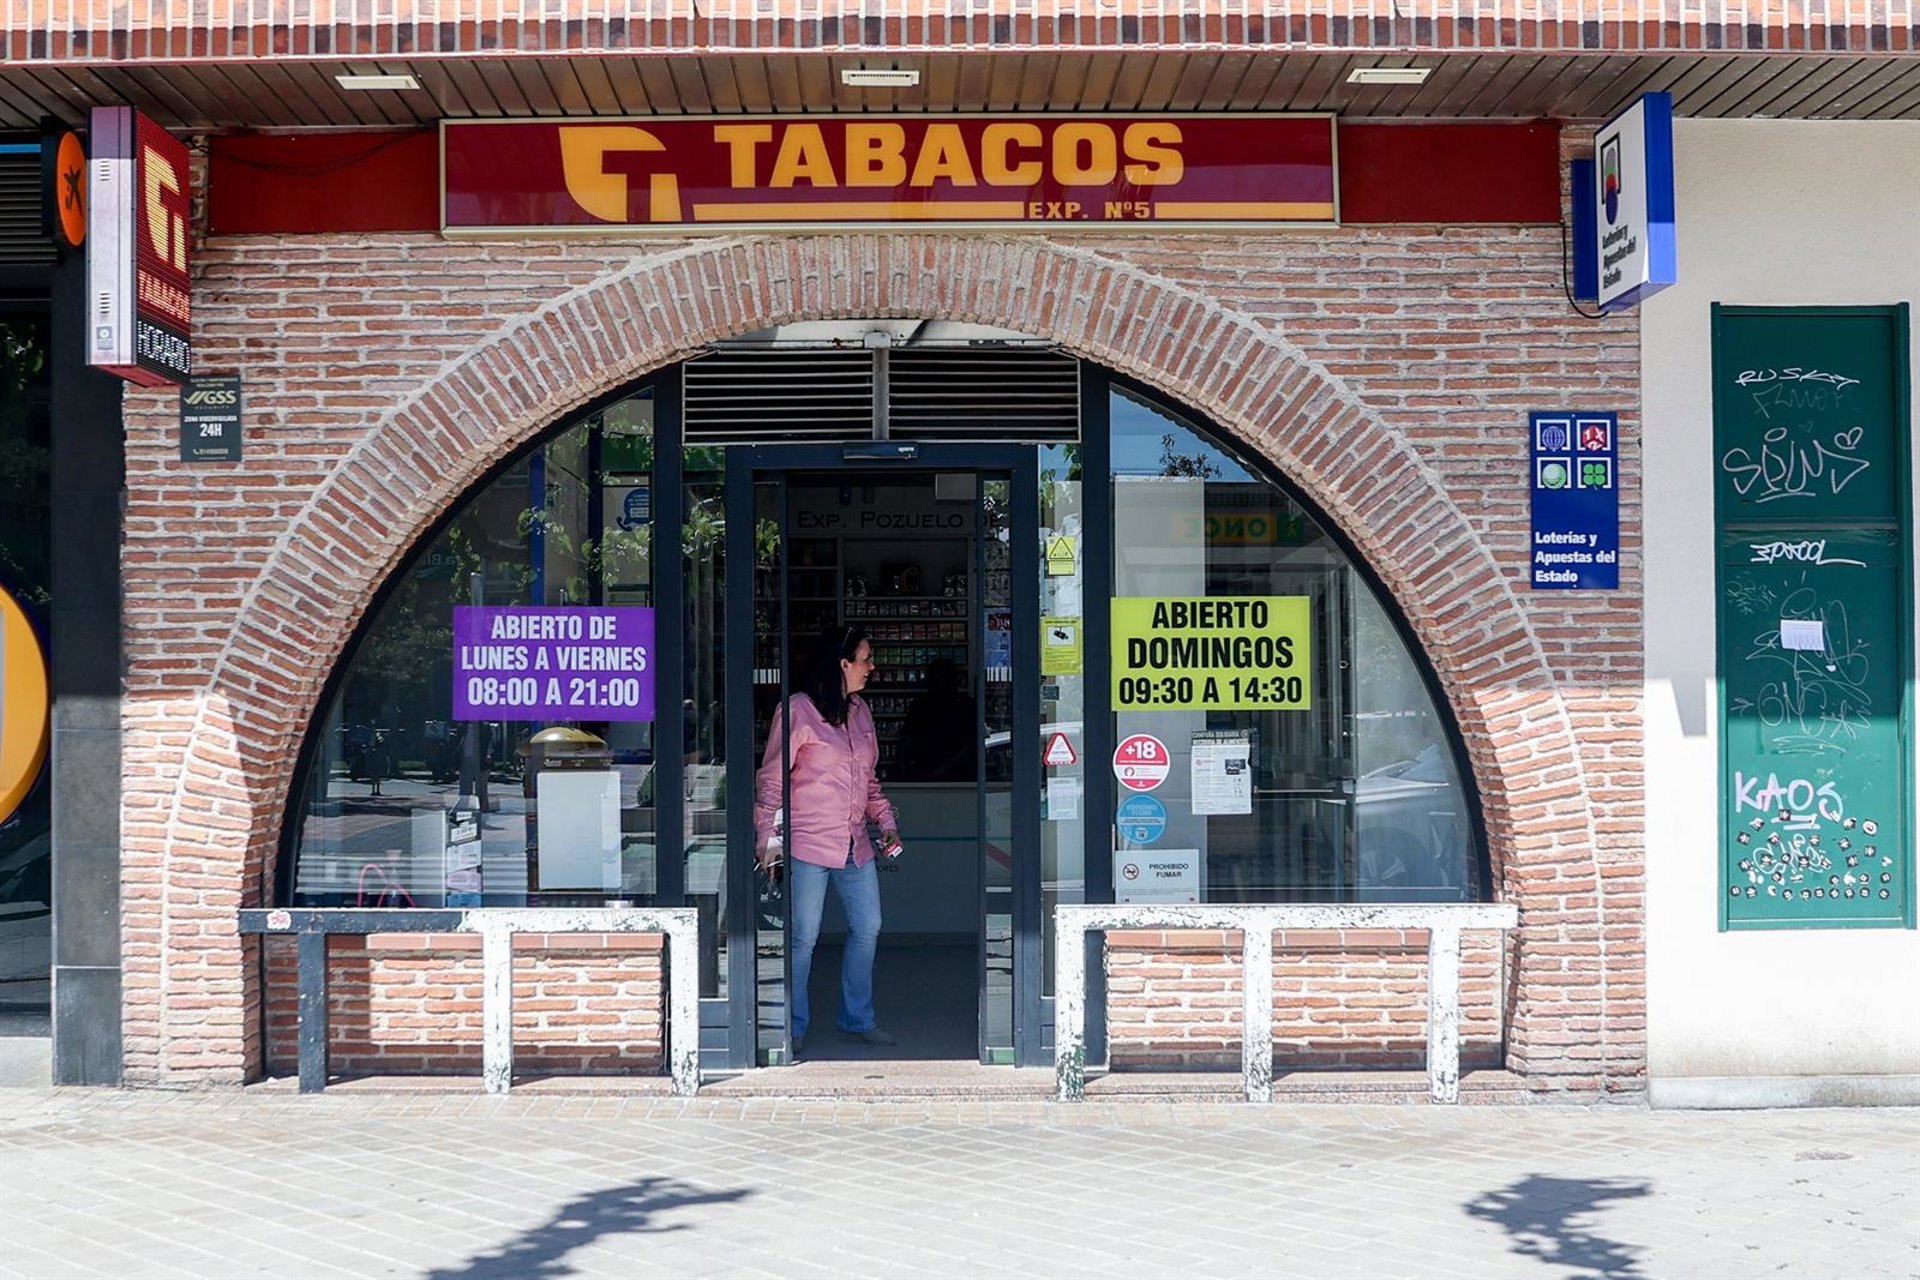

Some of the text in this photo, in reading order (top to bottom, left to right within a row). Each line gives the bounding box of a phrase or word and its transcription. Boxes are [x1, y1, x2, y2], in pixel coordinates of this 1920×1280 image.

[713, 122, 1184, 189] TABACOS
[1029, 201, 1089, 219] EXP.
[203, 390, 237, 405] GSS
[199, 423, 223, 437] 24H
[1535, 531, 1598, 547] Loterías y
[1535, 549, 1616, 565] Apuestas del
[1535, 569, 1579, 583] Estado
[1152, 600, 1268, 629] ABIERTO
[491, 615, 617, 640] ABIERTO DE
[461, 646, 647, 672] LUNES A VIERNES
[1128, 636, 1294, 669] DOMINGOS
[467, 677, 640, 707] 08:00 A 21:00
[1119, 676, 1302, 704] 09:30 A 14:30
[1125, 740, 1157, 759] +18
[1734, 771, 1844, 822] KAOS
